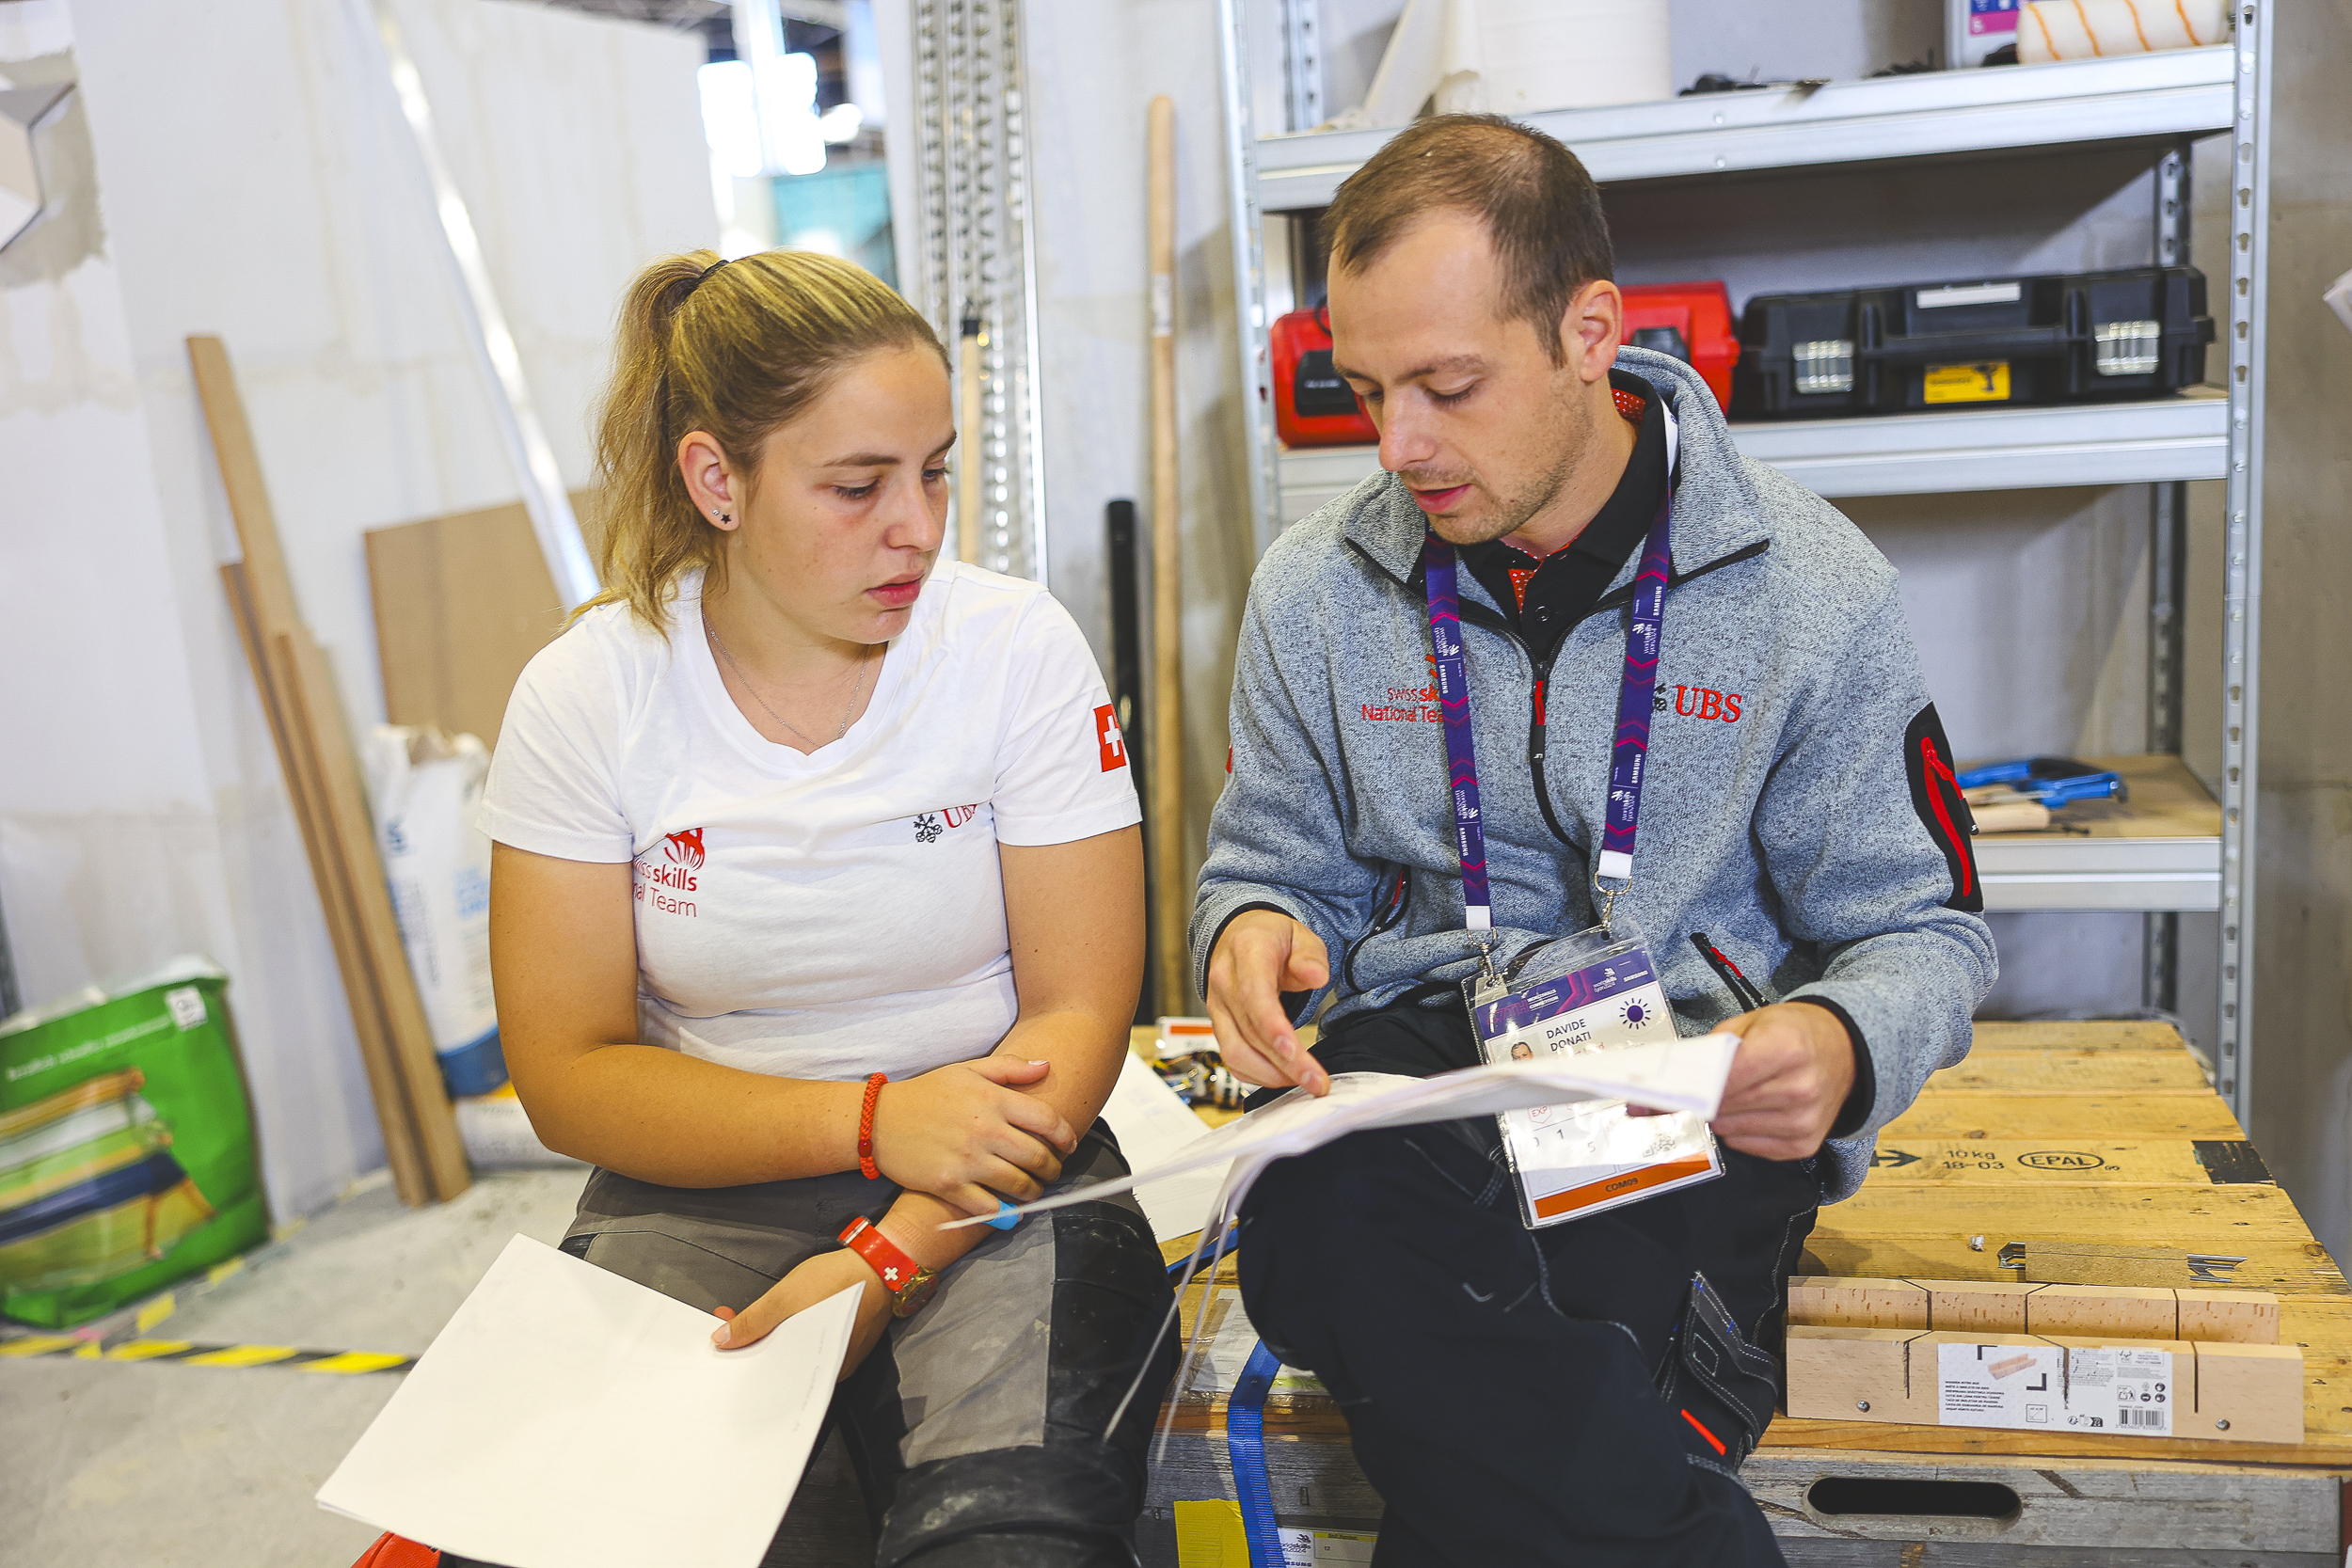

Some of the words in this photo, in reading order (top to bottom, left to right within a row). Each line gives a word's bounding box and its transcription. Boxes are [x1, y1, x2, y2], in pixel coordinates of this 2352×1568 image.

[1675, 684, 1742, 723] UBS
[1361, 704, 1417, 723] National
[1418, 705, 1444, 723] Tea
[653, 863, 698, 892] skills
[650, 886, 698, 918] Team
[1546, 1019, 1587, 1039] DAVIDE
[1549, 1031, 1592, 1053] DONATI
[1531, 1105, 1549, 1117] EXP
[1946, 1149, 1968, 1158] 10
[2030, 1156, 2091, 1166] EPAL
[1942, 1161, 2005, 1170] 18-03
[1605, 1177, 1639, 1193] COM09
